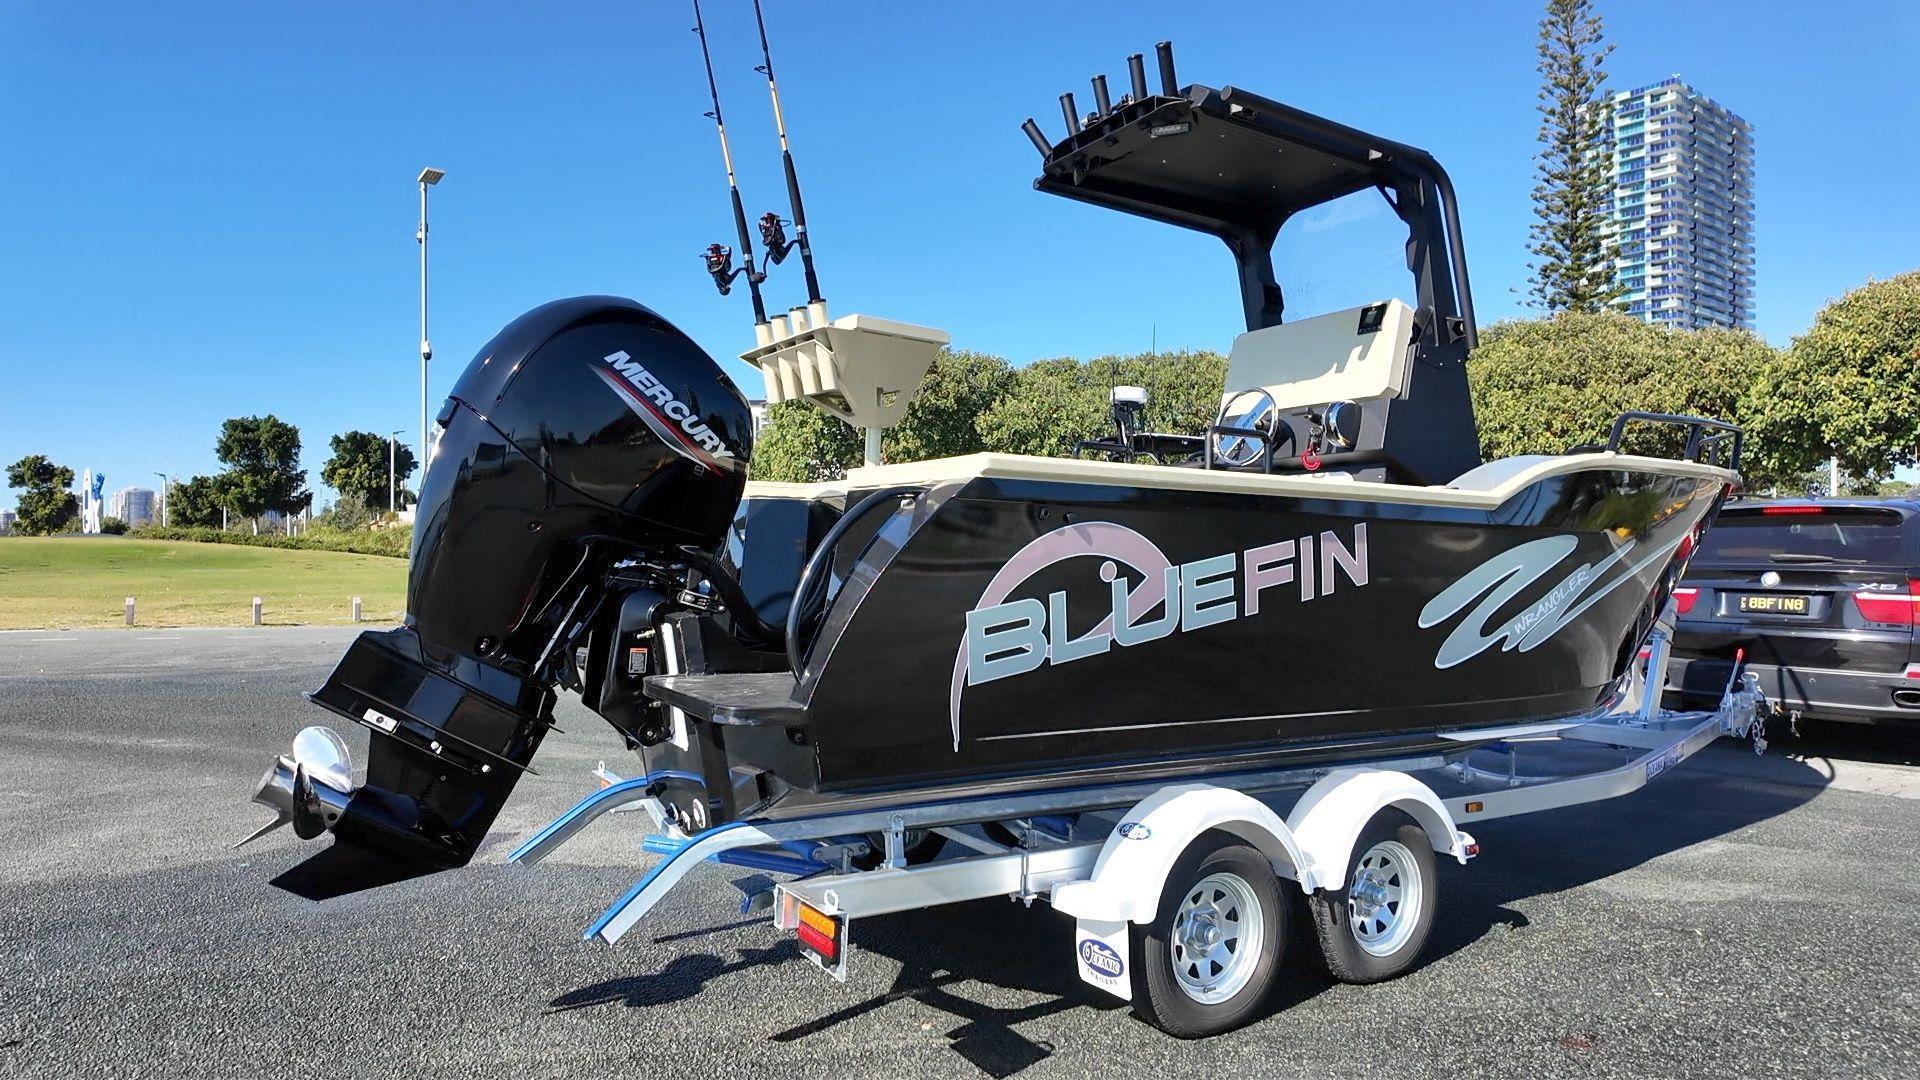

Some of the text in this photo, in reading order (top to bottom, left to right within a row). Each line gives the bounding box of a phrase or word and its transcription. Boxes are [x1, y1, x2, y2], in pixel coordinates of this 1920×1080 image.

[603, 350, 735, 459] MERCURY
[965, 522, 1370, 687] BLUEFIN
[1513, 569, 1590, 635] WRANGLER
